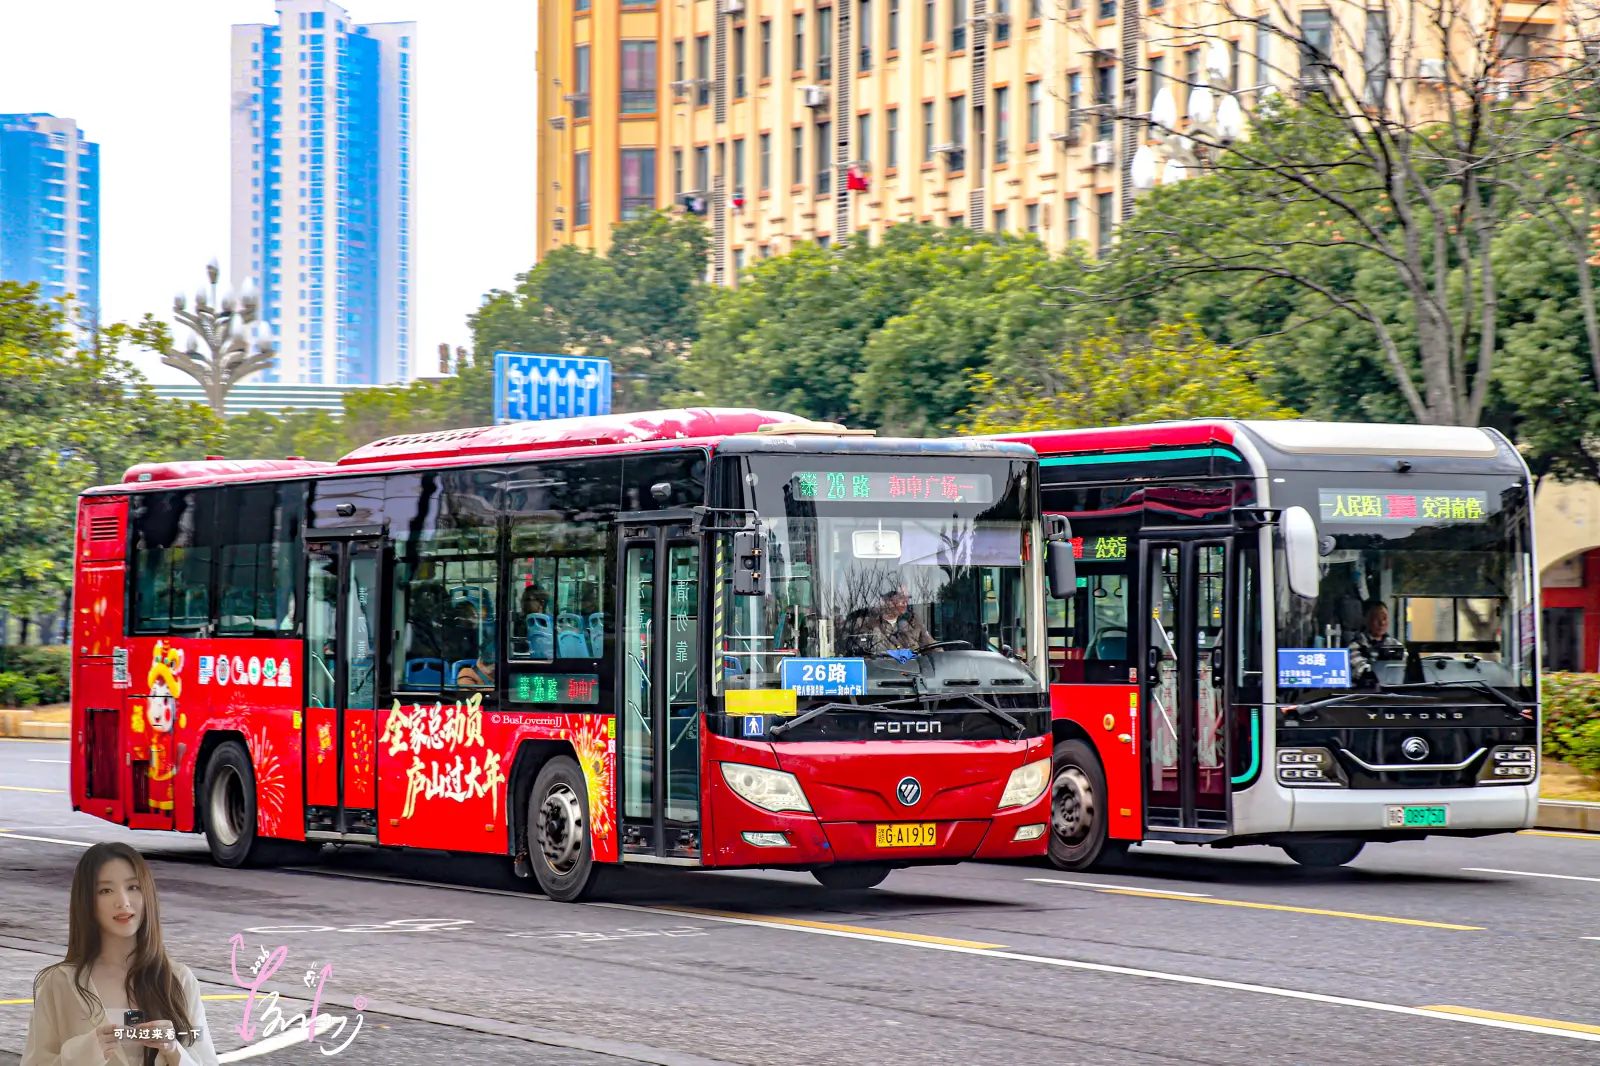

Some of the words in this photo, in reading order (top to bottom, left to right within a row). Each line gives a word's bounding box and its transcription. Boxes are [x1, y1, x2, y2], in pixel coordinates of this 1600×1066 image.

[802, 663, 847, 683] 26路
[379, 692, 485, 757] 全家总动员
[1367, 713, 1464, 721] YUTONG
[873, 721, 942, 734] FOTON
[401, 748, 505, 821] 庐山过大年
